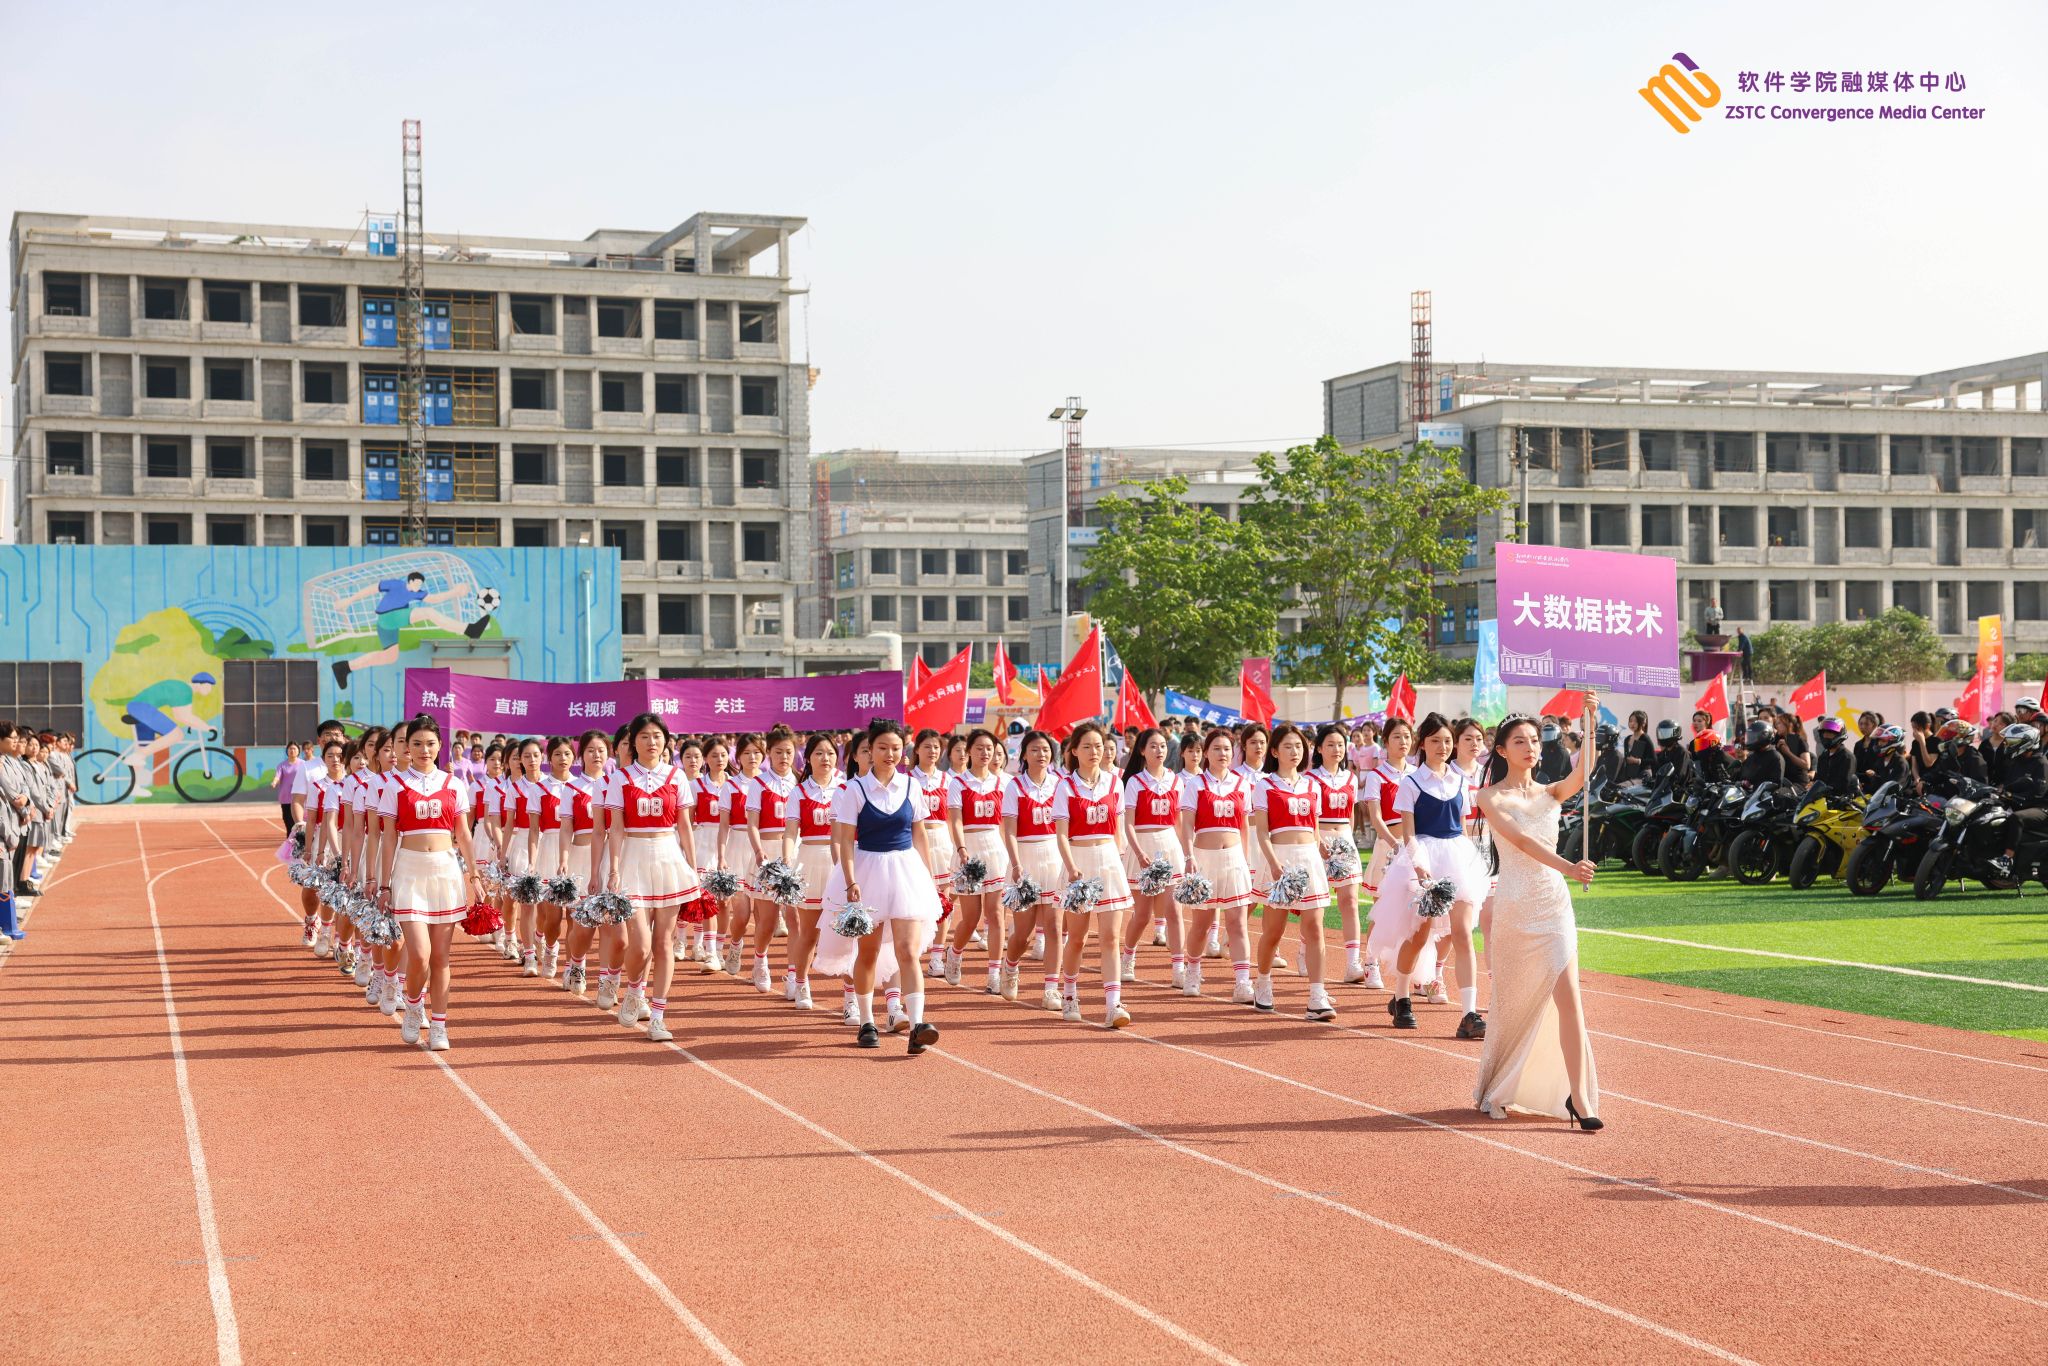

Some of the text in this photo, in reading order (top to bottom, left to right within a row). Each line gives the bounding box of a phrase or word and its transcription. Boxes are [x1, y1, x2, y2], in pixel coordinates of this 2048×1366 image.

[1513, 591, 1663, 638] 大数据技术
[421, 690, 885, 718] 热点 直播 长视频 商城 关注 朋友 郑州
[415, 798, 442, 820] 08
[636, 797, 664, 817] 08
[974, 800, 995, 818] 08
[1151, 798, 1170, 816] 08
[1213, 800, 1235, 818] 08
[1288, 797, 1311, 817] 08
[1329, 792, 1348, 809] 08
[1086, 804, 1109, 826] 08
